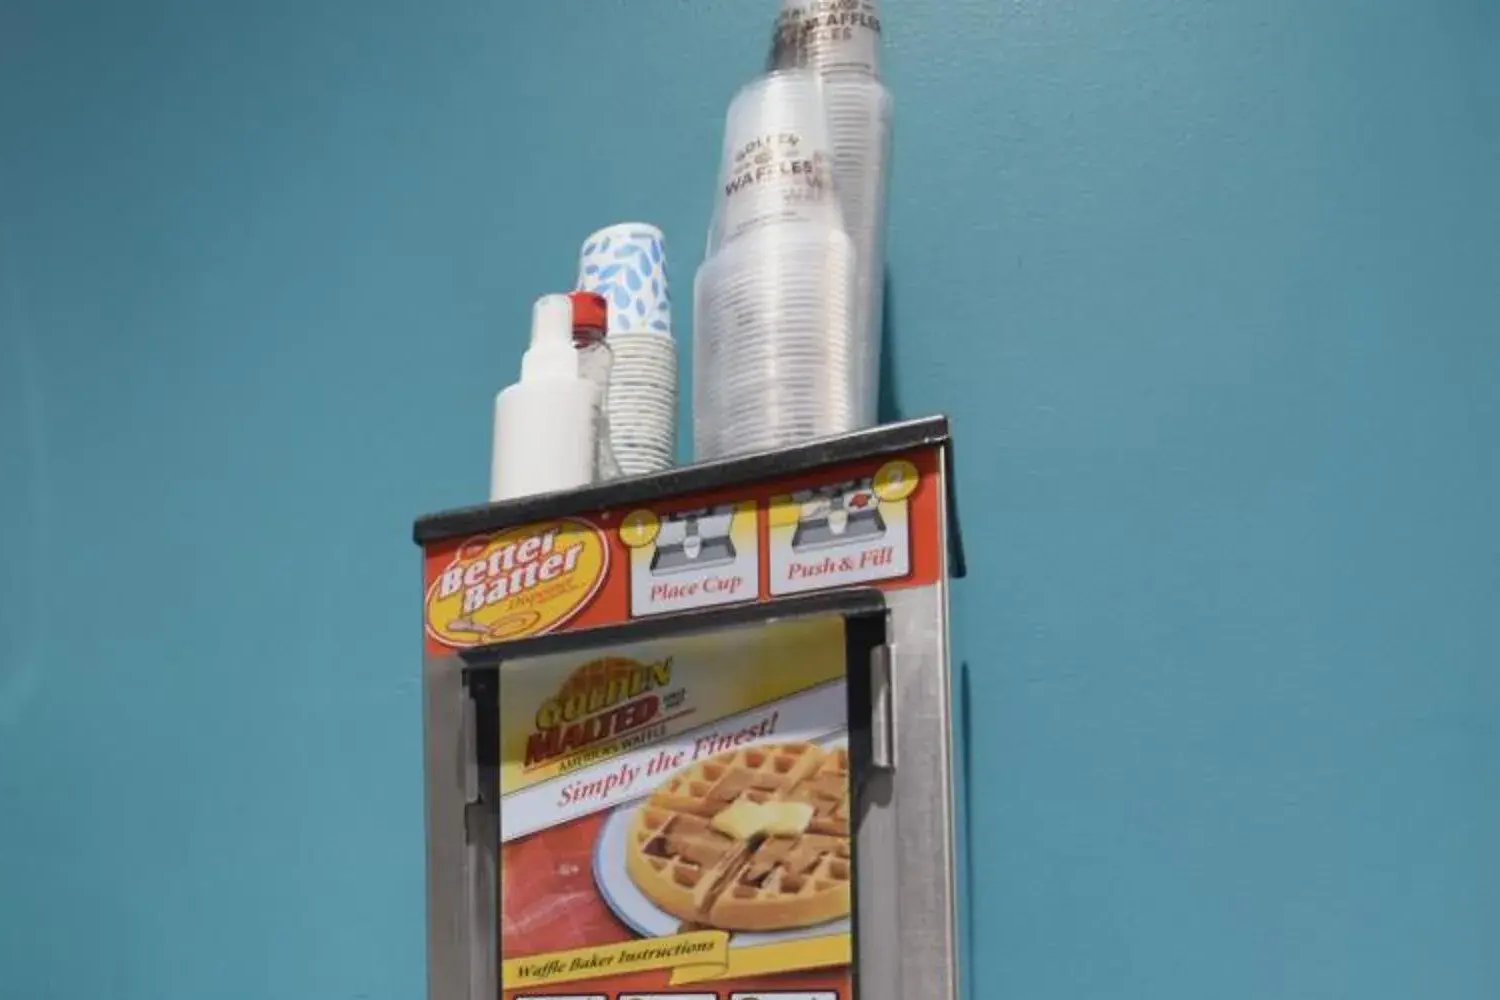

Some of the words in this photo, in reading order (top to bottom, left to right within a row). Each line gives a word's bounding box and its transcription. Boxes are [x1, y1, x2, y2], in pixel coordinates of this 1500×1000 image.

[439, 529, 559, 600] Better
[463, 542, 583, 614] Batter
[650, 580, 699, 602] Place
[701, 574, 743, 596] Cup
[787, 557, 837, 580] Push
[835, 555, 853, 572] &
[858, 548, 894, 570] Fill
[557, 765, 641, 808] Simply
[647, 751, 685, 778] the
[691, 712, 779, 760] Finest!
[516, 960, 566, 979] Waffle
[569, 954, 614, 974] Baker
[618, 939, 716, 964] Instructions
